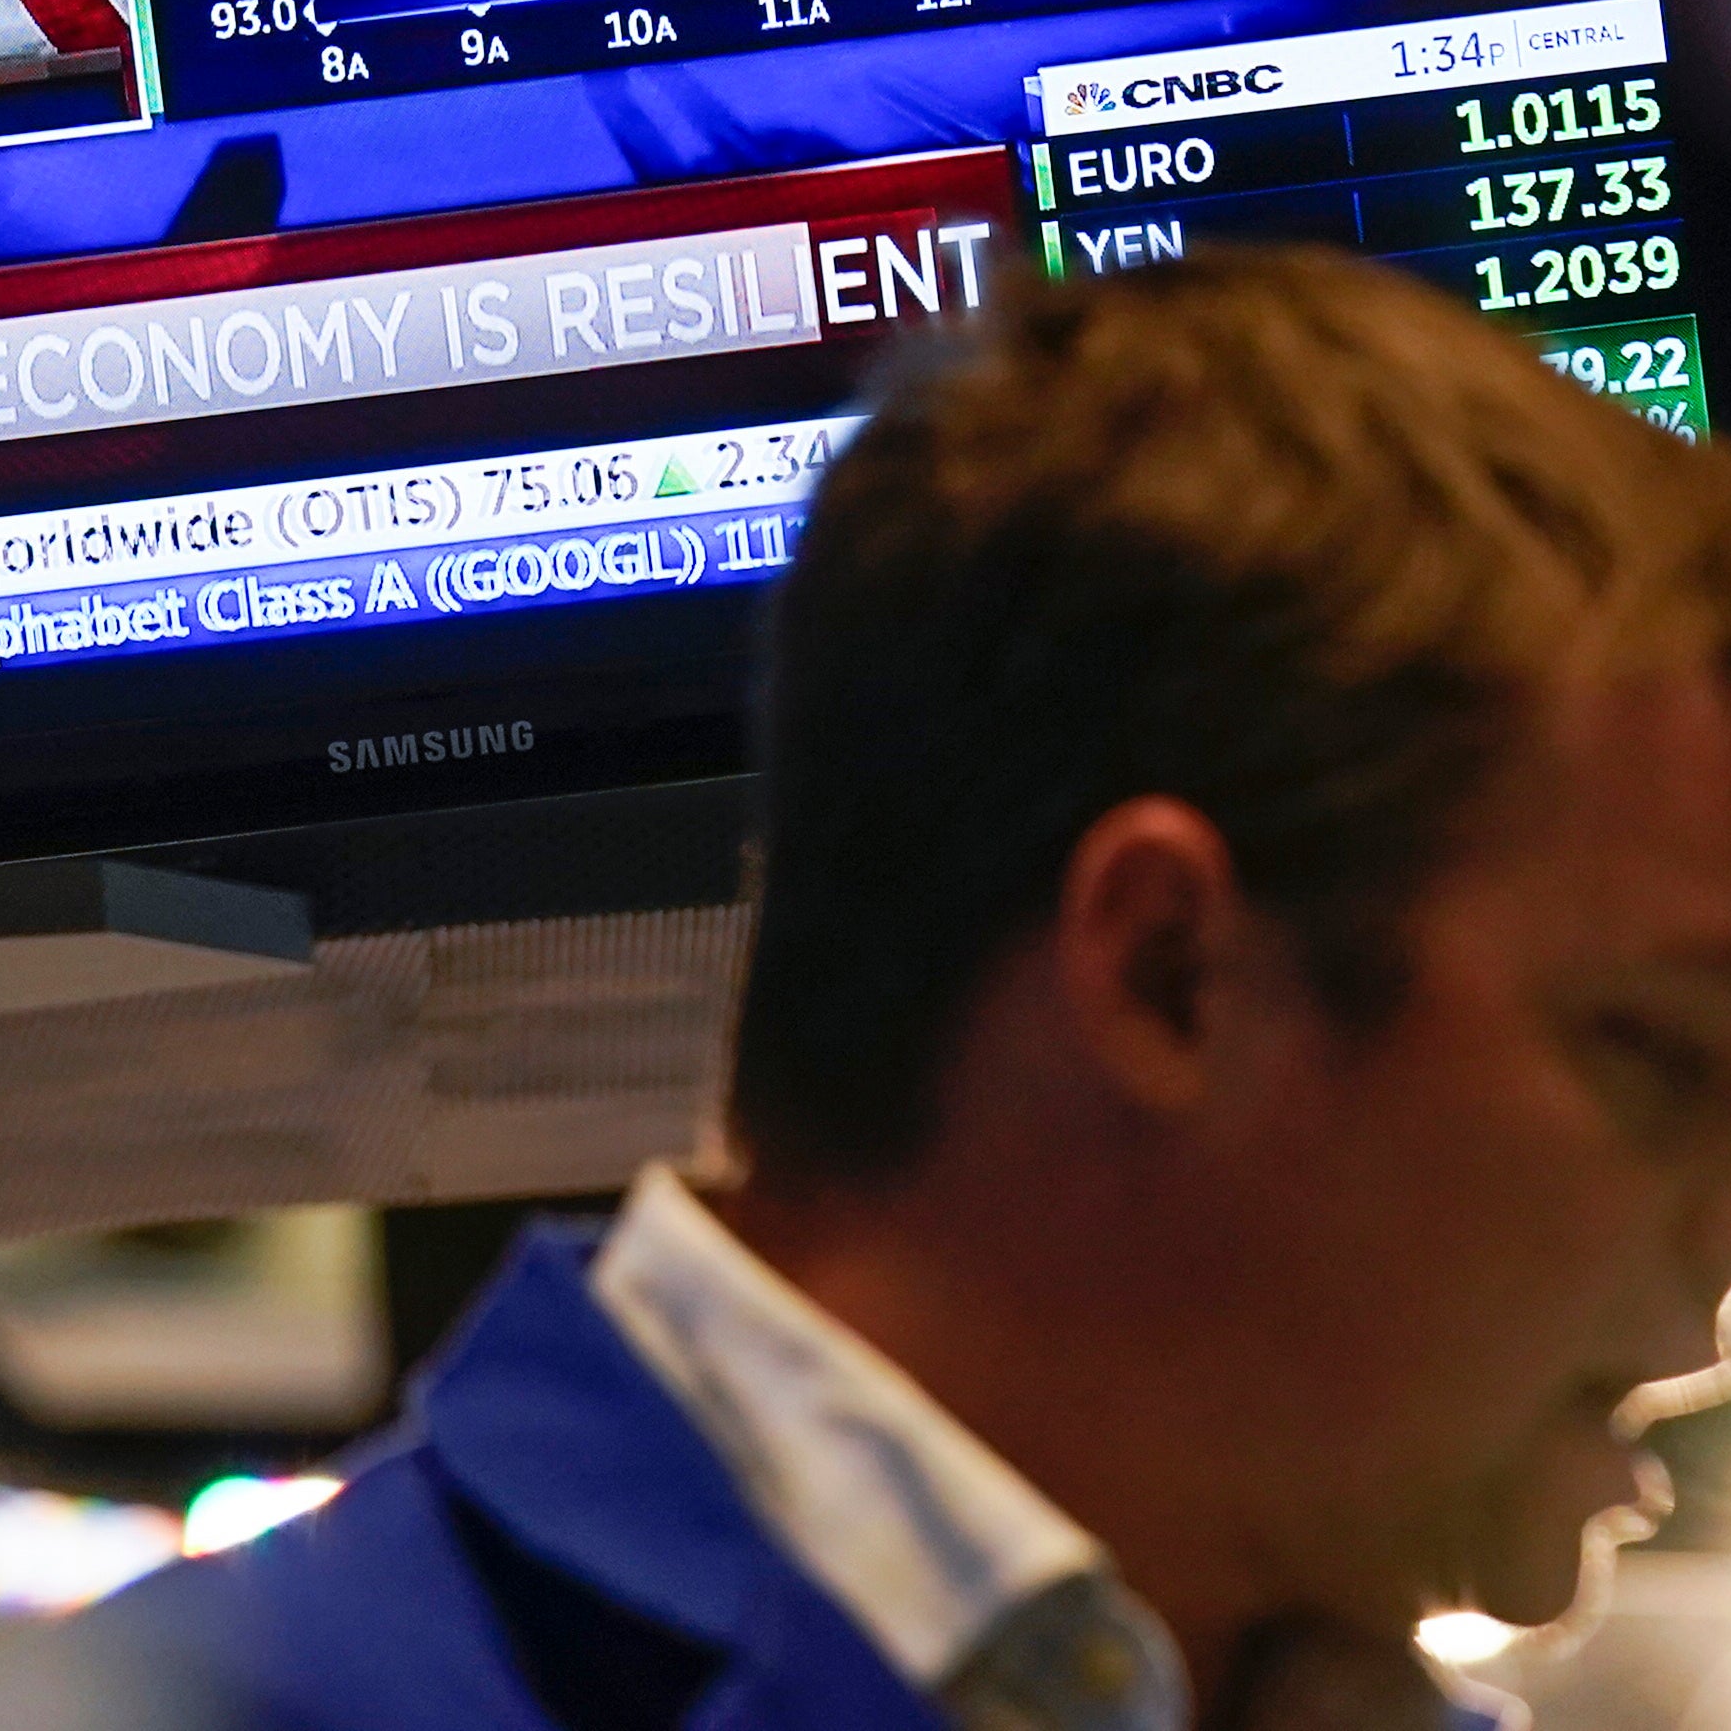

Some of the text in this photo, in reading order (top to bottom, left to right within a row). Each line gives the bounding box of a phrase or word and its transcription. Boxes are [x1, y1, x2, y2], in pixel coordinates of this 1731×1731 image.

[321, 45, 370, 84] 8A
[460, 29, 510, 67] 9A
[604, 8, 678, 49] 10A
[1121, 64, 1285, 110] CNBC
[1528, 23, 1625, 52] CENTRAL
[1068, 78, 1662, 197] EURO 1.0115
[1075, 156, 1671, 276] YEN 137.33
[439, 279, 521, 369] IS
[543, 221, 991, 360] RESILIENT
[1474, 235, 1681, 312] 1.2039
[276, 475, 462, 551] (OTIS)
[482, 452, 639, 517] 75.06
[196, 574, 354, 636] Class
[364, 559, 419, 615] A
[714, 512, 808, 572] 11
[327, 719, 535, 774] SAMSUNG
